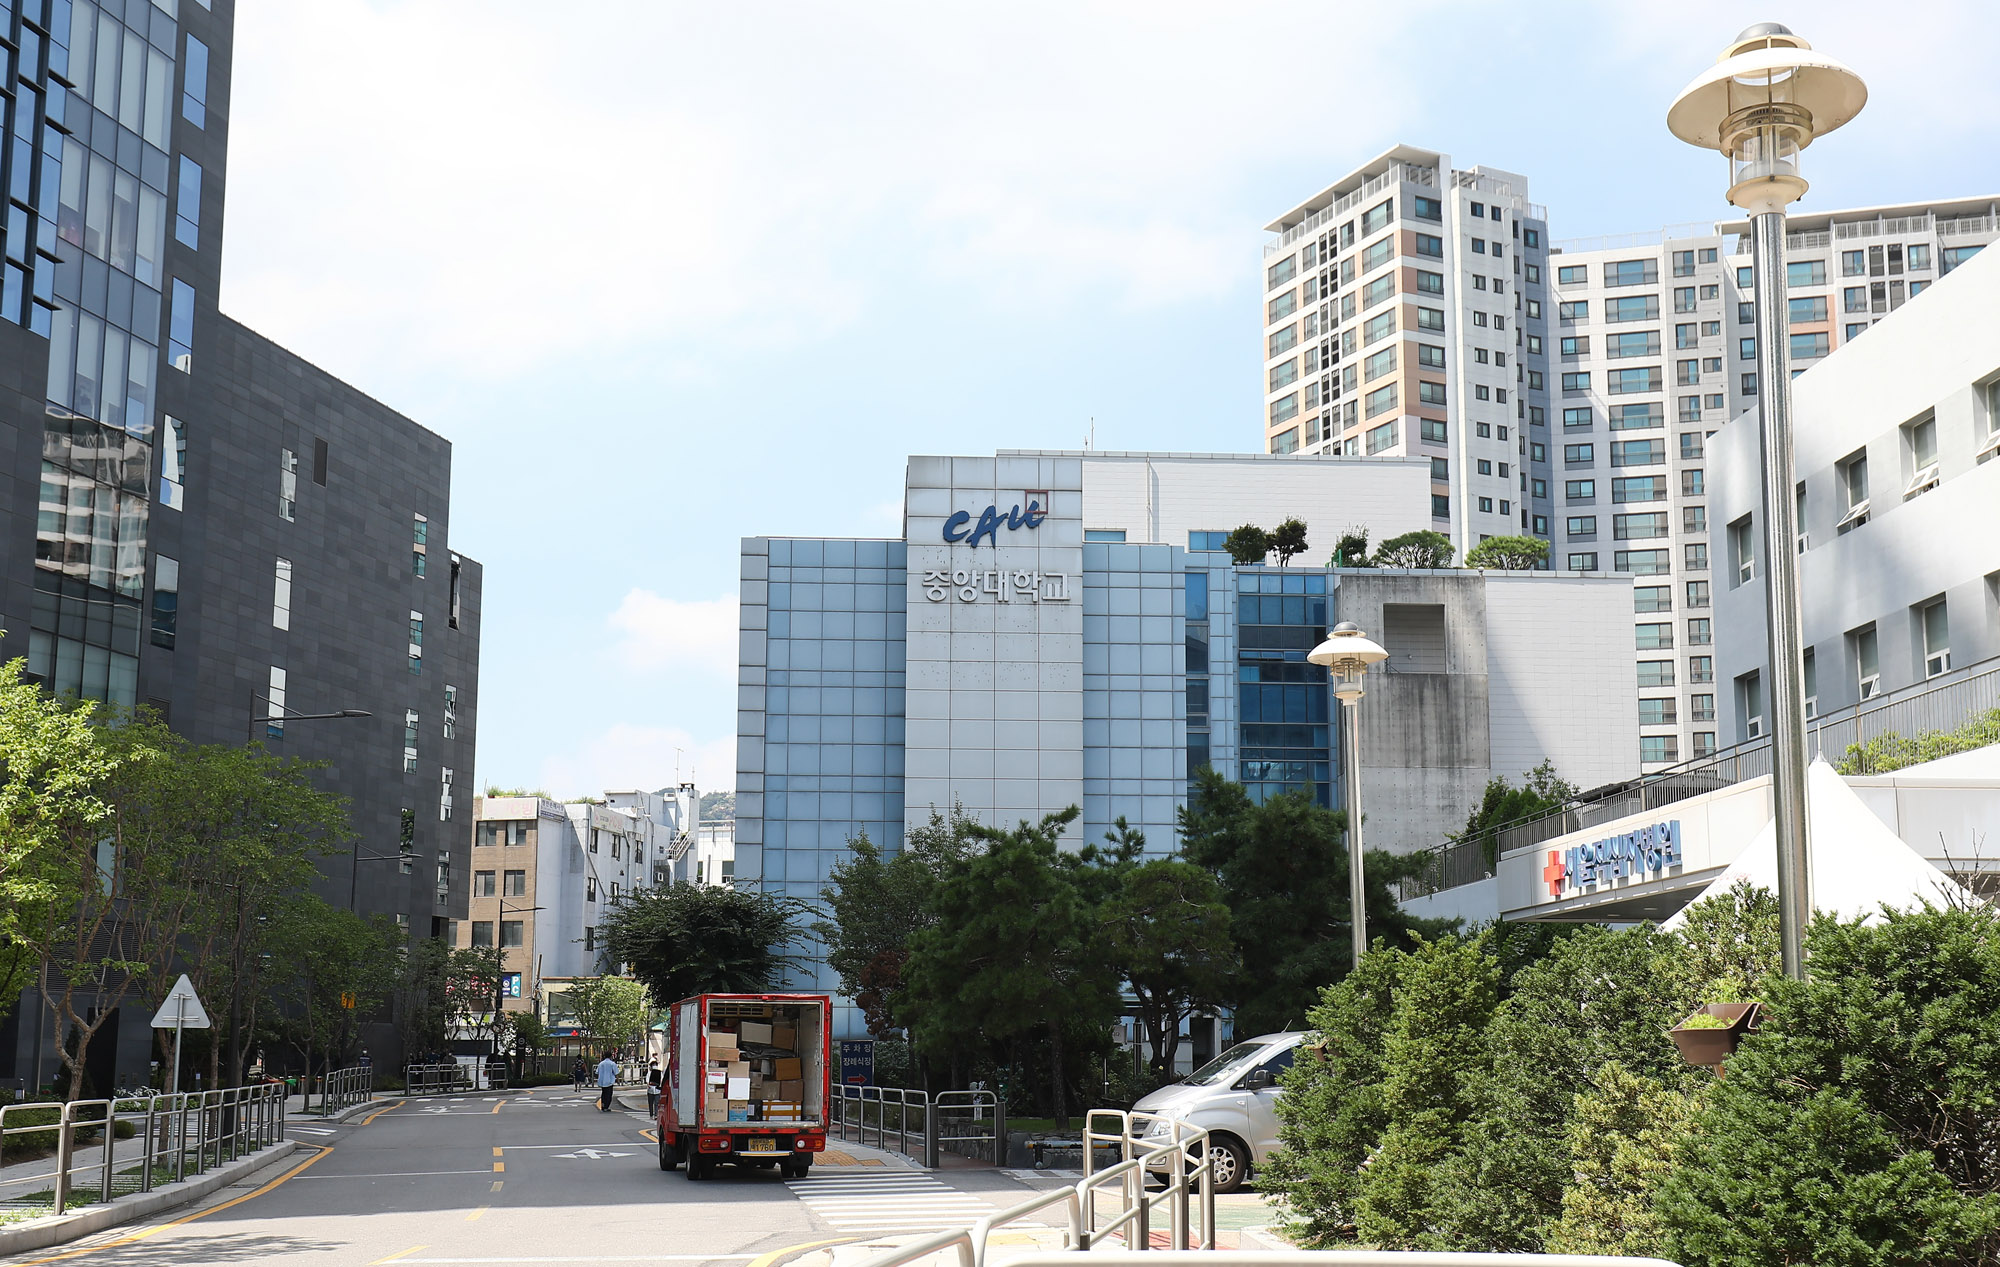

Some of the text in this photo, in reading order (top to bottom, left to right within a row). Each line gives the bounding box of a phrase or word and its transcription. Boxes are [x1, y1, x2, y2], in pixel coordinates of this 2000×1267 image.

[922, 569, 1071, 603] 중앙대학교
[1563, 820, 1682, 887] 서울적십자병원
[843, 1057, 871, 1066] 장례식장
